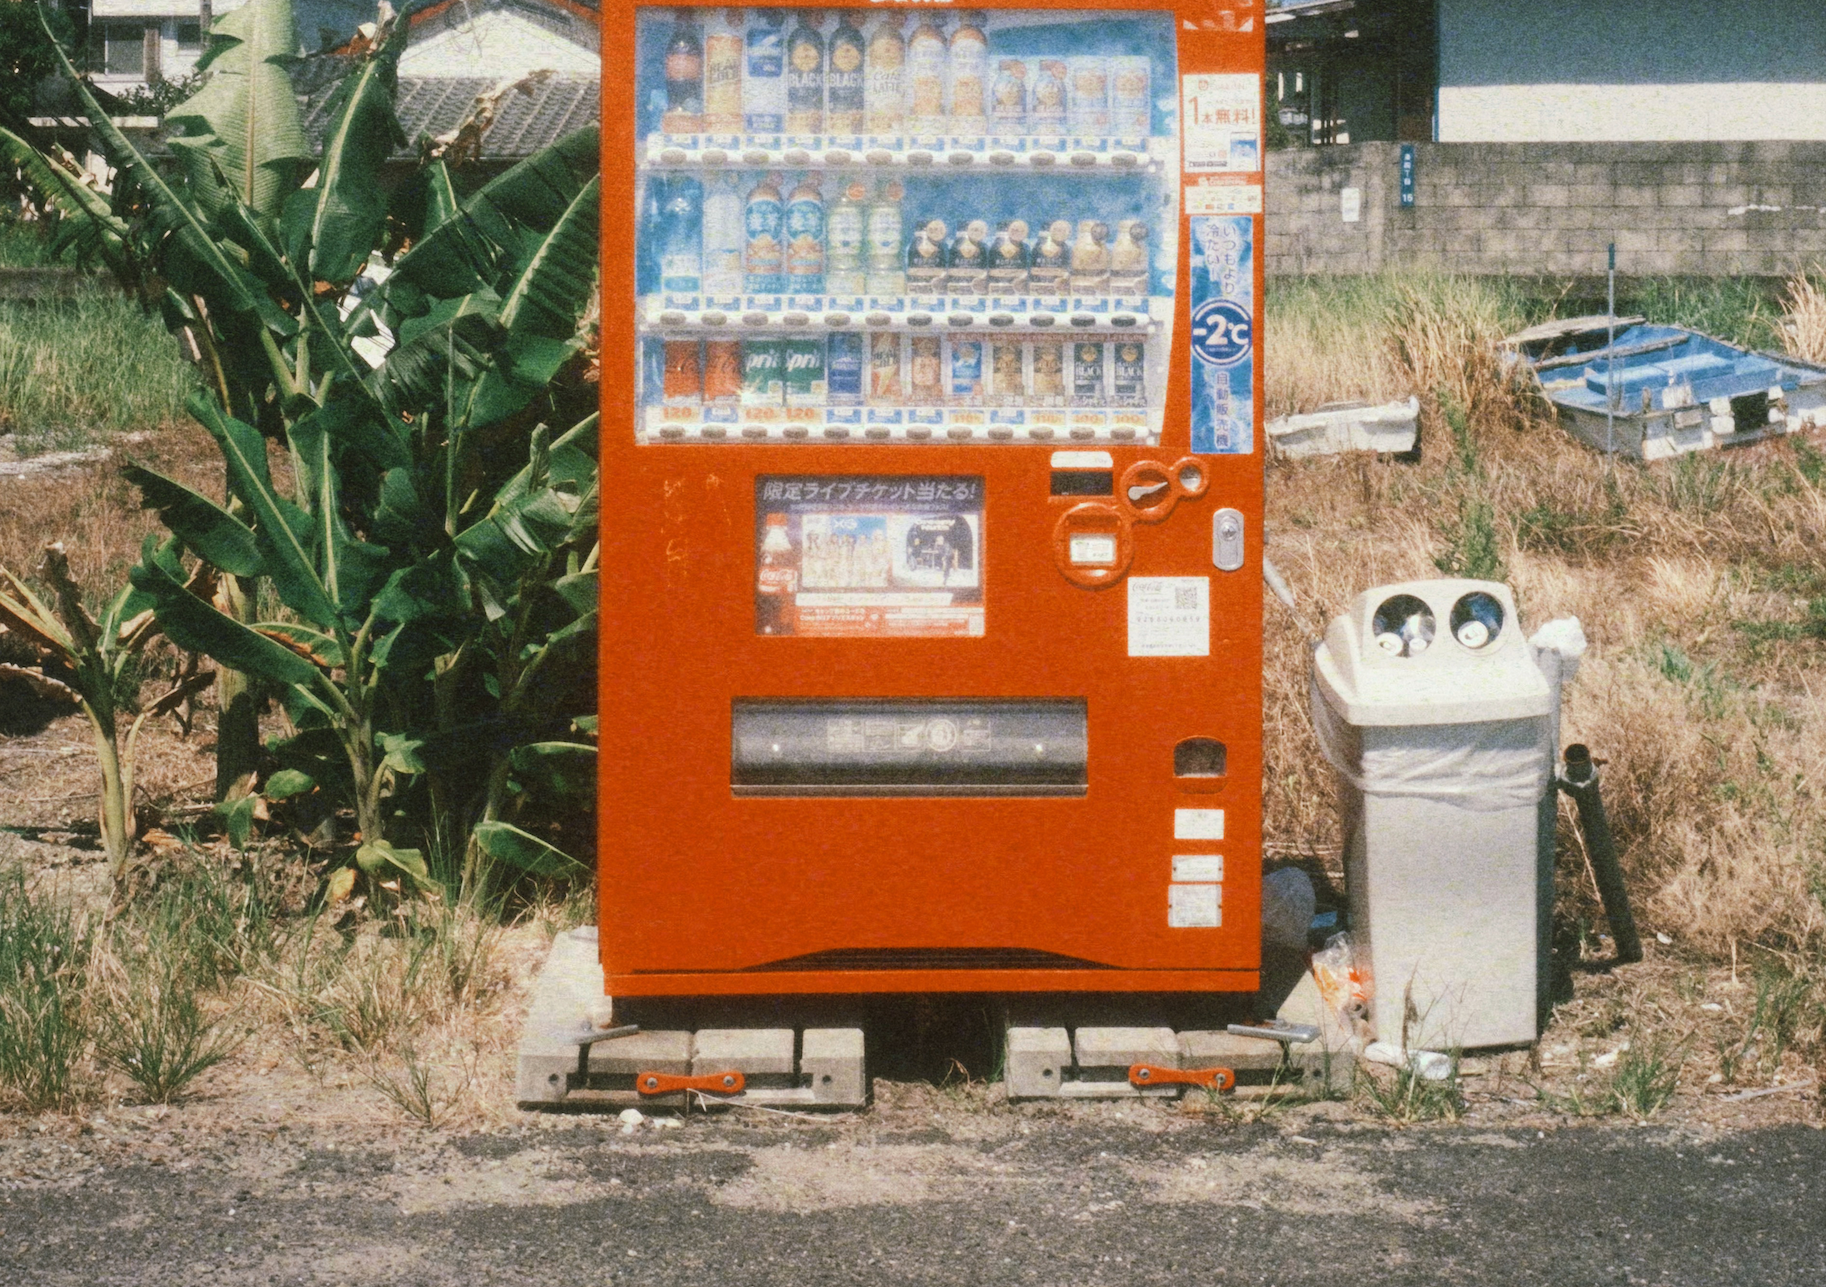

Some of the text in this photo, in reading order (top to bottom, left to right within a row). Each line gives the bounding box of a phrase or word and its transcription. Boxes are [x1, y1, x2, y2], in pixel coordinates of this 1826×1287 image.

[1222, 225, 1237, 294] いつもより
[662, 407, 692, 419] 120
[745, 407, 775, 419] 120
[786, 407, 815, 419] 120
[1216, 372, 1229, 448] 自動販売機
[763, 481, 977, 501] 限定ライブチケット当たる!
